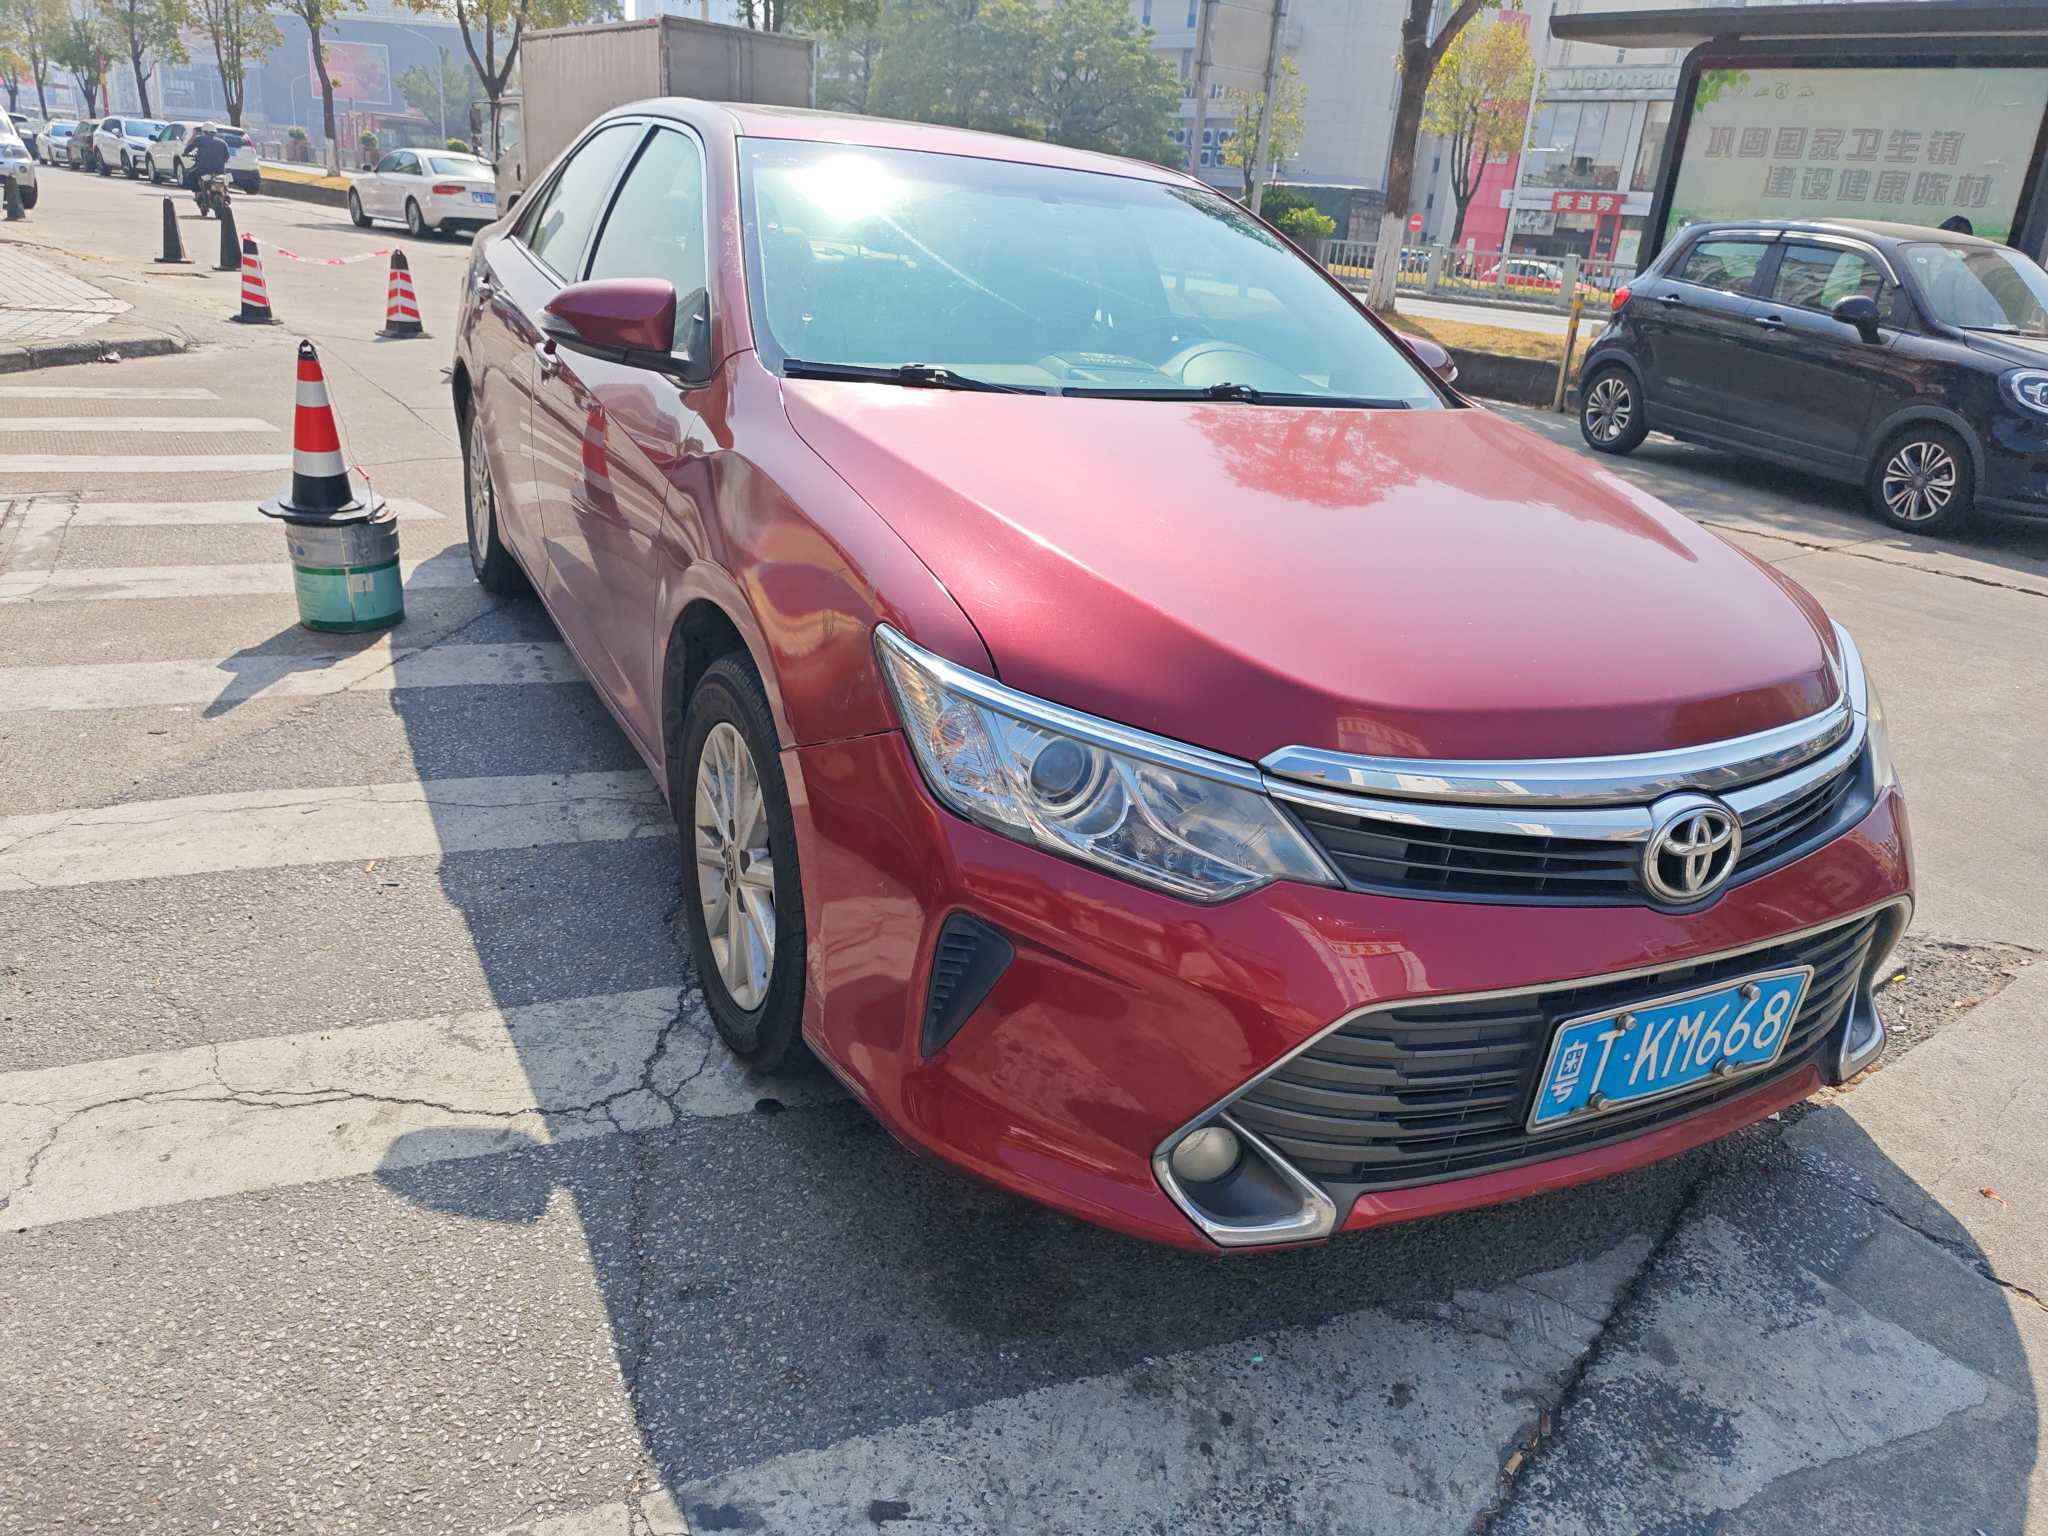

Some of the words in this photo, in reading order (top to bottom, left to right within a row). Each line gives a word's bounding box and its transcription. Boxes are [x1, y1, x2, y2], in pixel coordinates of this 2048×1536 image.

[1704, 126, 1965, 165] 巩固国家卫生镇
[1556, 194, 1614, 211] 麦当劳
[1762, 165, 1994, 208] 建设健康陈村
